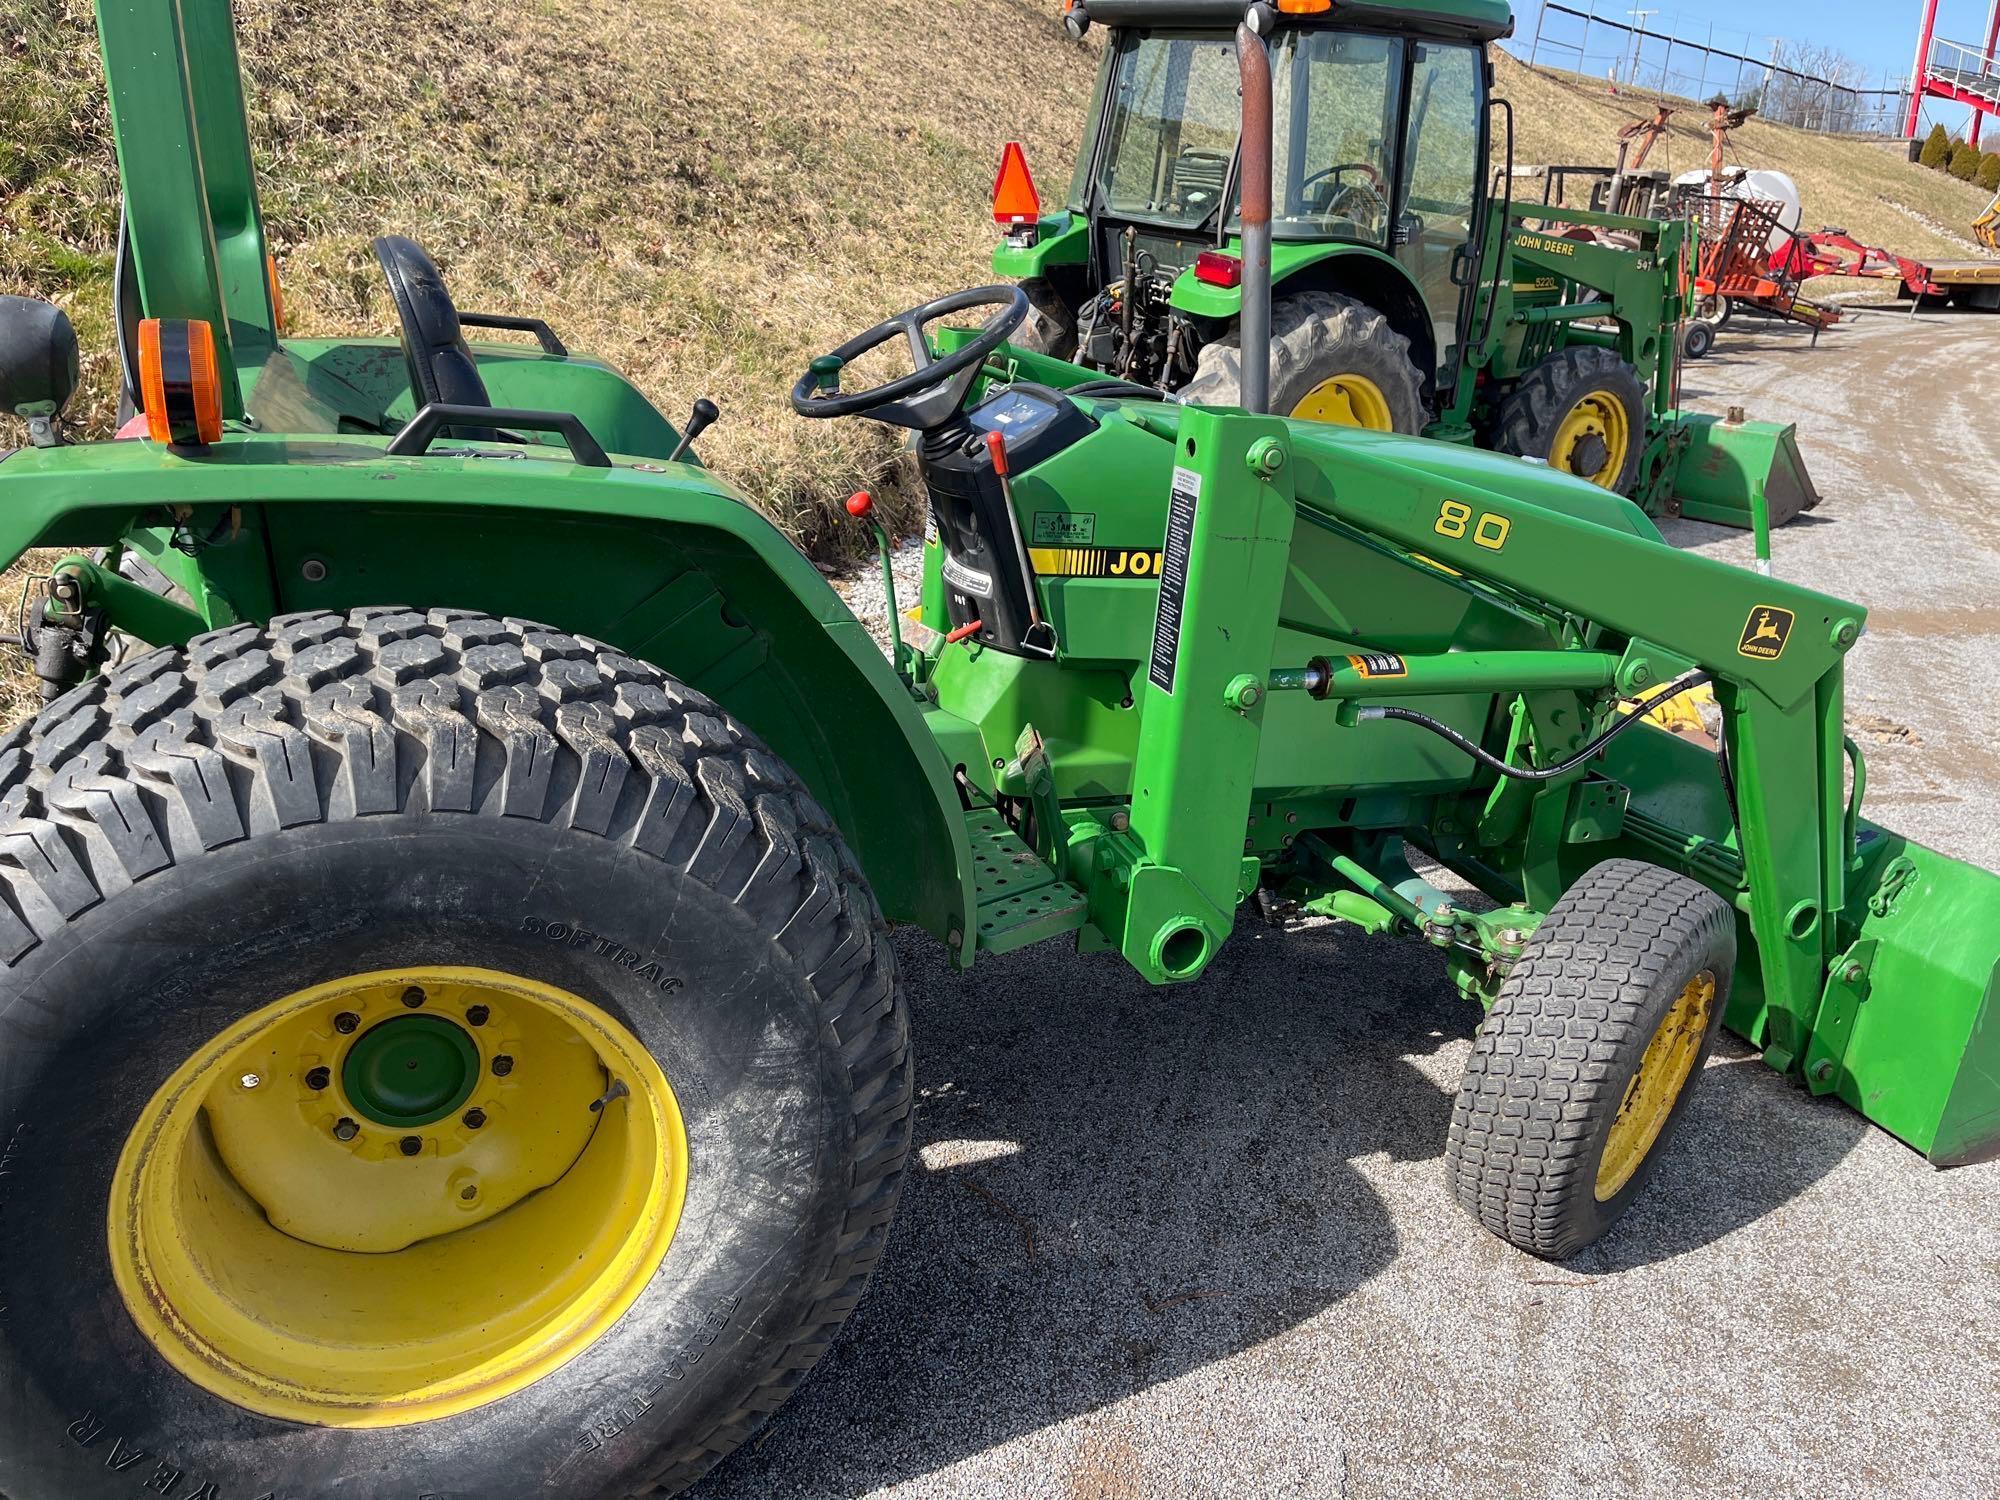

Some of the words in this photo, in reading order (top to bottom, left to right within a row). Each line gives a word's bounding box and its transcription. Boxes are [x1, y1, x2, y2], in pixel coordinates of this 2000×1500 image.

[1514, 235, 1540, 250] JOHN
[1544, 239, 1575, 256] DEERE
[1535, 277, 1555, 288] 5220
[1434, 499, 1512, 552] 80
[1741, 644, 1758, 653] JOHN
[1758, 646, 1778, 656] DEERE
[519, 914, 684, 996] SOFTRAC
[578, 1294, 742, 1453] TERRA-TIRE
[66, 1409, 275, 1500] YEAR
